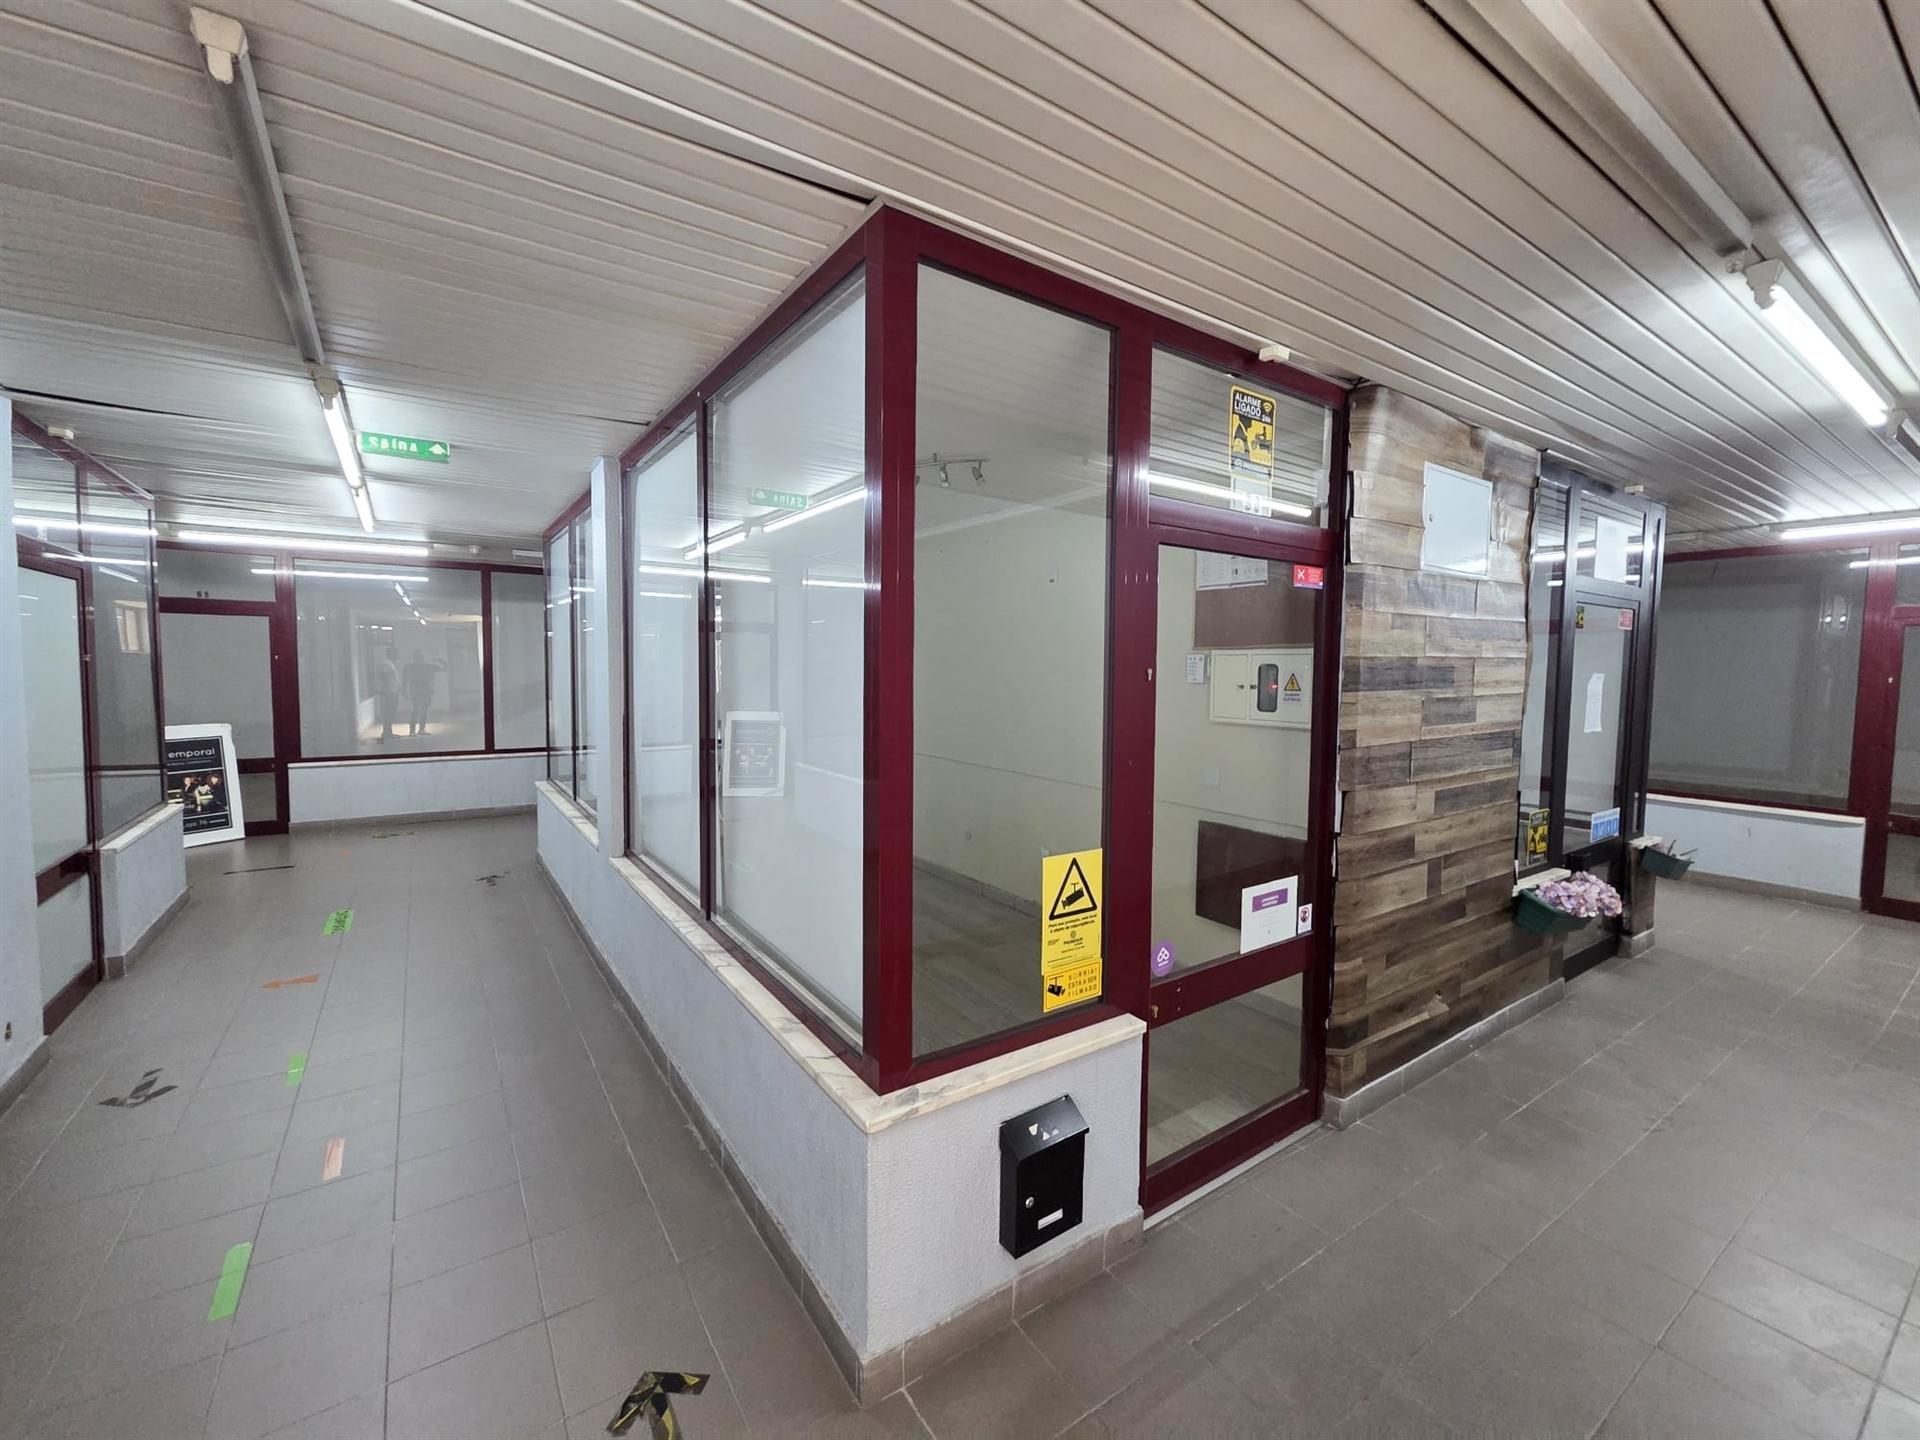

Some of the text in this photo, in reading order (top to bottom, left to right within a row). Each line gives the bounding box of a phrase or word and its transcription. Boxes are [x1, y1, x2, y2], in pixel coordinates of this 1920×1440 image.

[1234, 392, 1262, 408] ALARME
[1234, 401, 1262, 417] LIGADO
[168, 747, 216, 759] emporal
[1068, 984, 1098, 997] FILMADO
